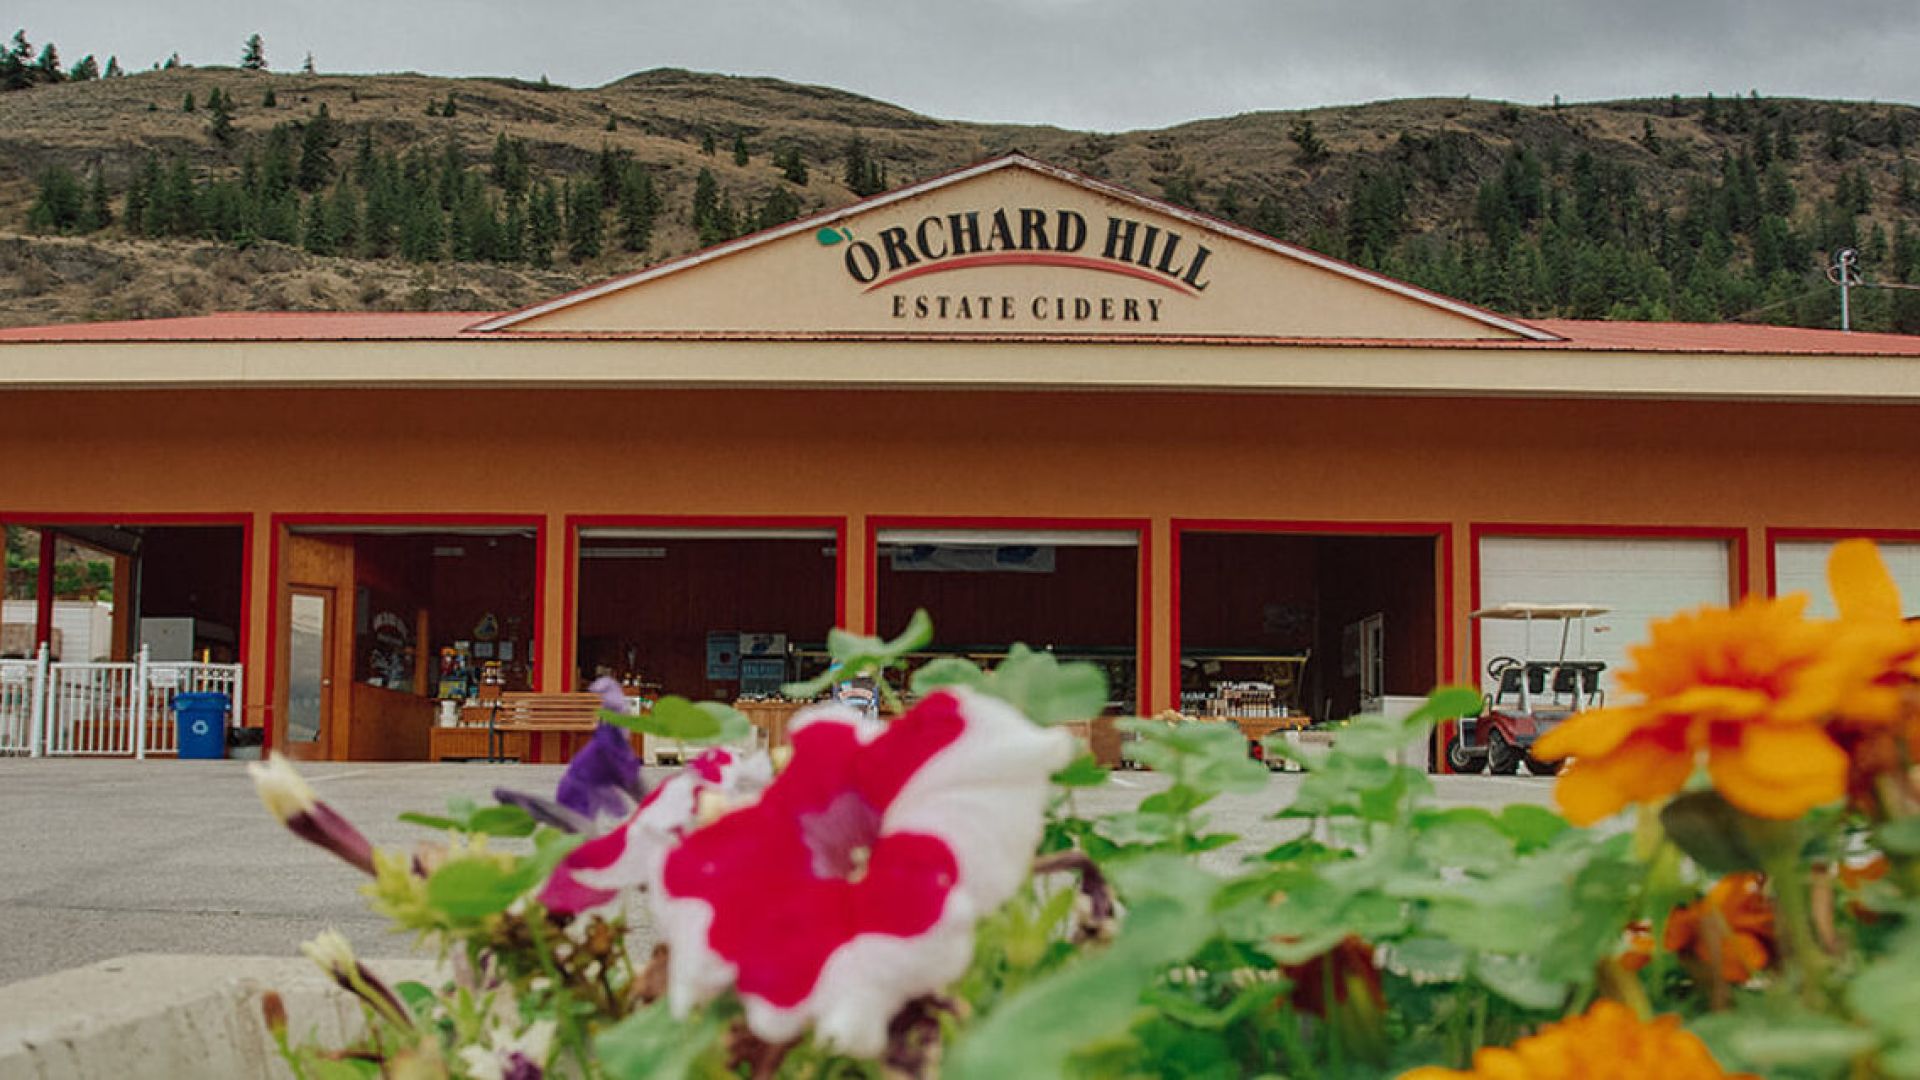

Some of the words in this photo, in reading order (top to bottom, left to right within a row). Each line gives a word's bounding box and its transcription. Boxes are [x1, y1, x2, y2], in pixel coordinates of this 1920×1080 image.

[844, 207, 1087, 284] ORCHARD
[1102, 215, 1212, 292] HILL
[892, 294, 1016, 319] ESTATE
[1032, 297, 1163, 321] CIDERY
